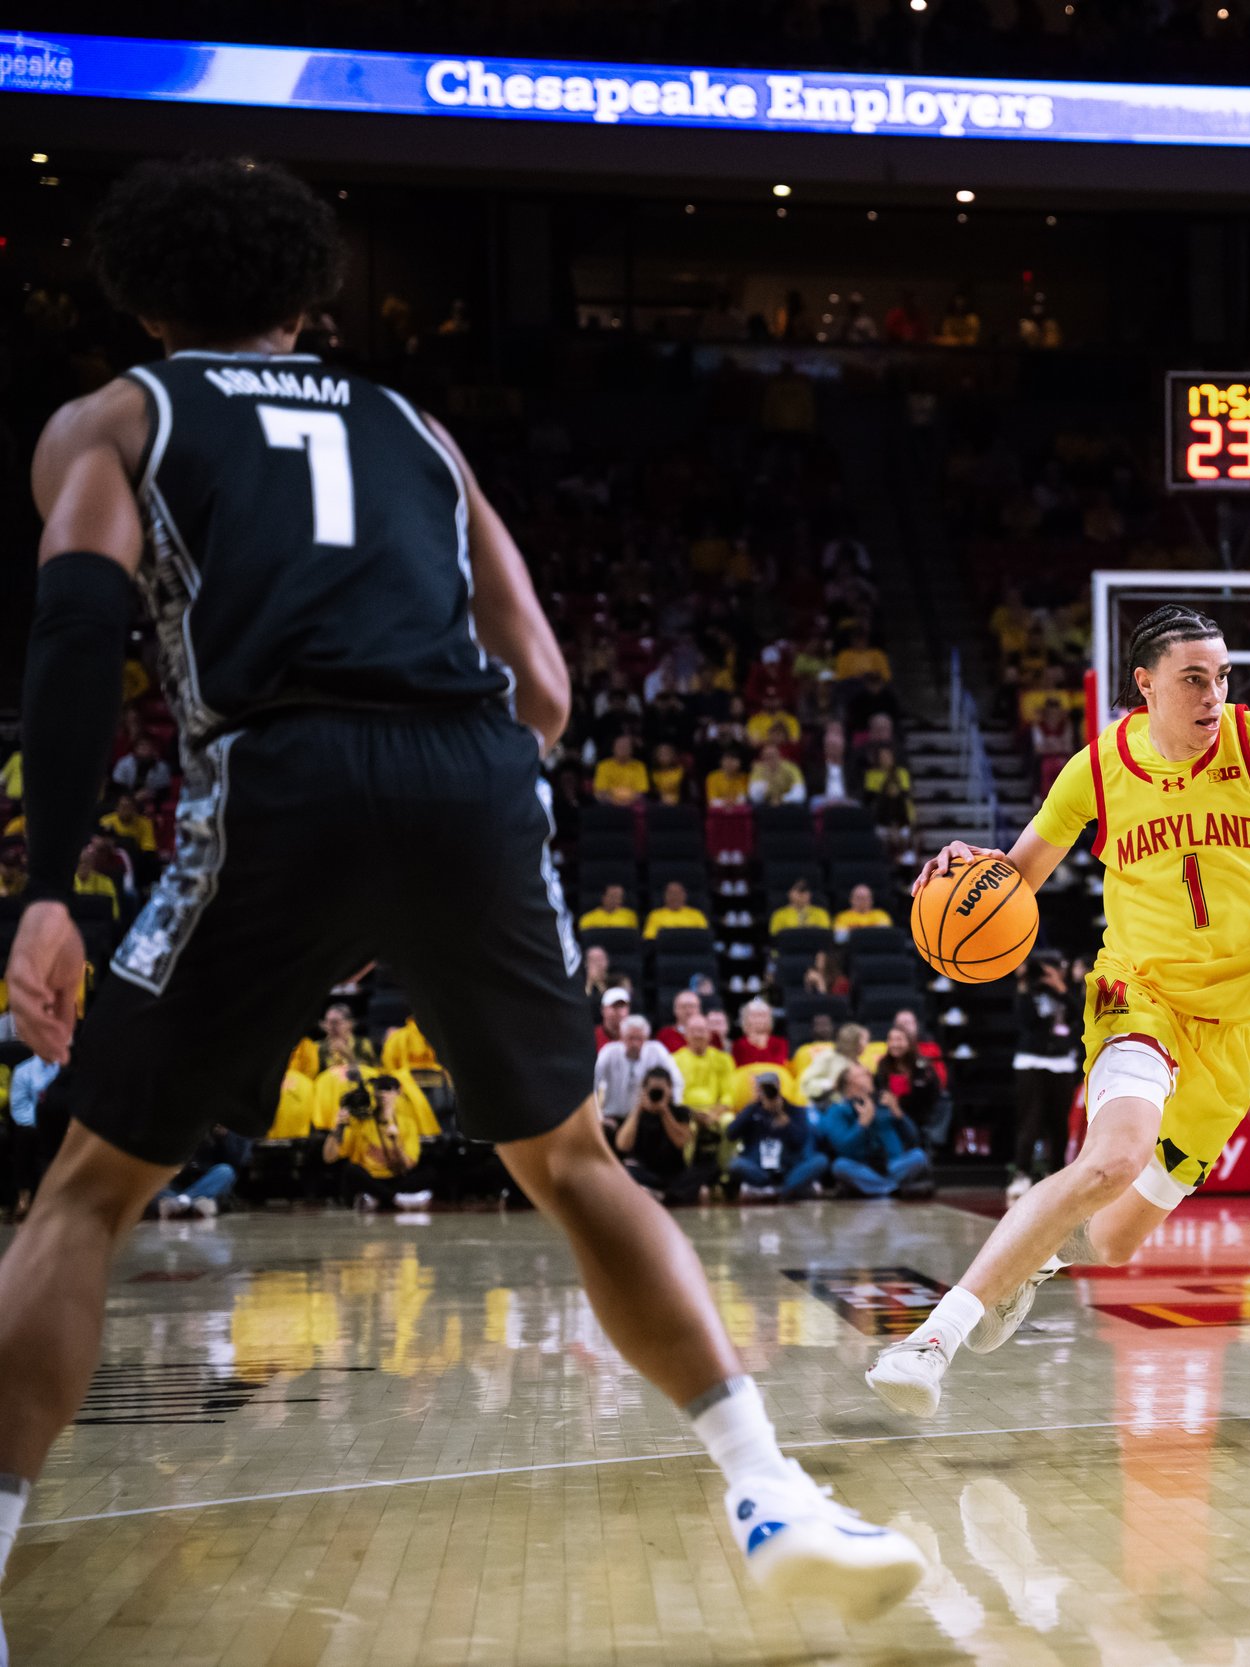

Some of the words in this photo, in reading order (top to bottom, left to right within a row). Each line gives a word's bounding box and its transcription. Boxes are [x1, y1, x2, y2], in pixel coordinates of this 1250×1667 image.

[426, 60, 757, 123] Chesapeake
[766, 75, 1054, 136] Employers
[255, 402, 355, 547] 7
[956, 861, 1015, 917] Wilson
[1182, 852, 1210, 930] 1
[1094, 974, 1129, 1019] M
